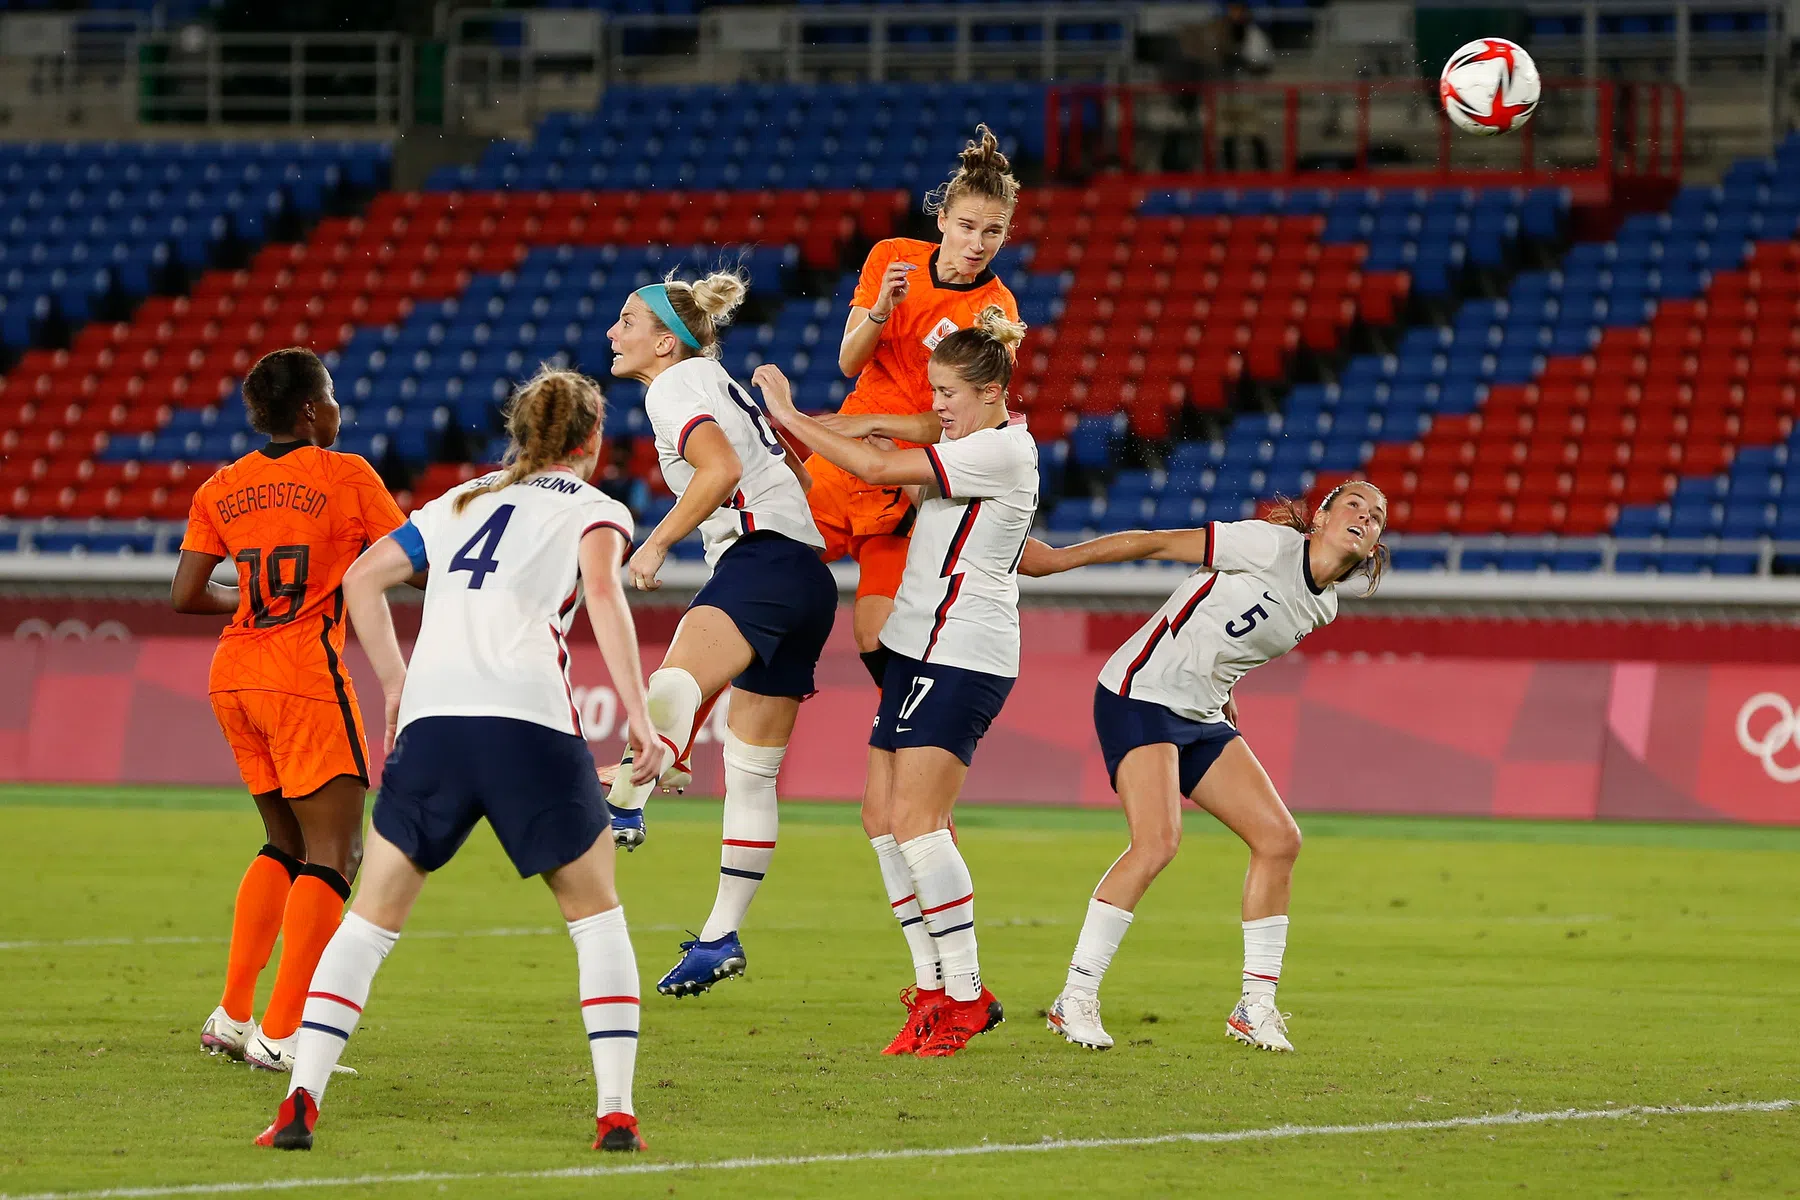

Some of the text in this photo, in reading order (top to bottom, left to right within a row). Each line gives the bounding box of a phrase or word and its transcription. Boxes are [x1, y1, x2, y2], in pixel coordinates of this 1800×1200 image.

[727, 382, 784, 456] 8
[216, 482, 327, 524] BEERENSTEYN
[470, 475, 583, 495] SARUNN
[447, 503, 516, 590] 4
[236, 545, 309, 628] 19
[1225, 603, 1269, 638] 5
[898, 676, 935, 720] 17
